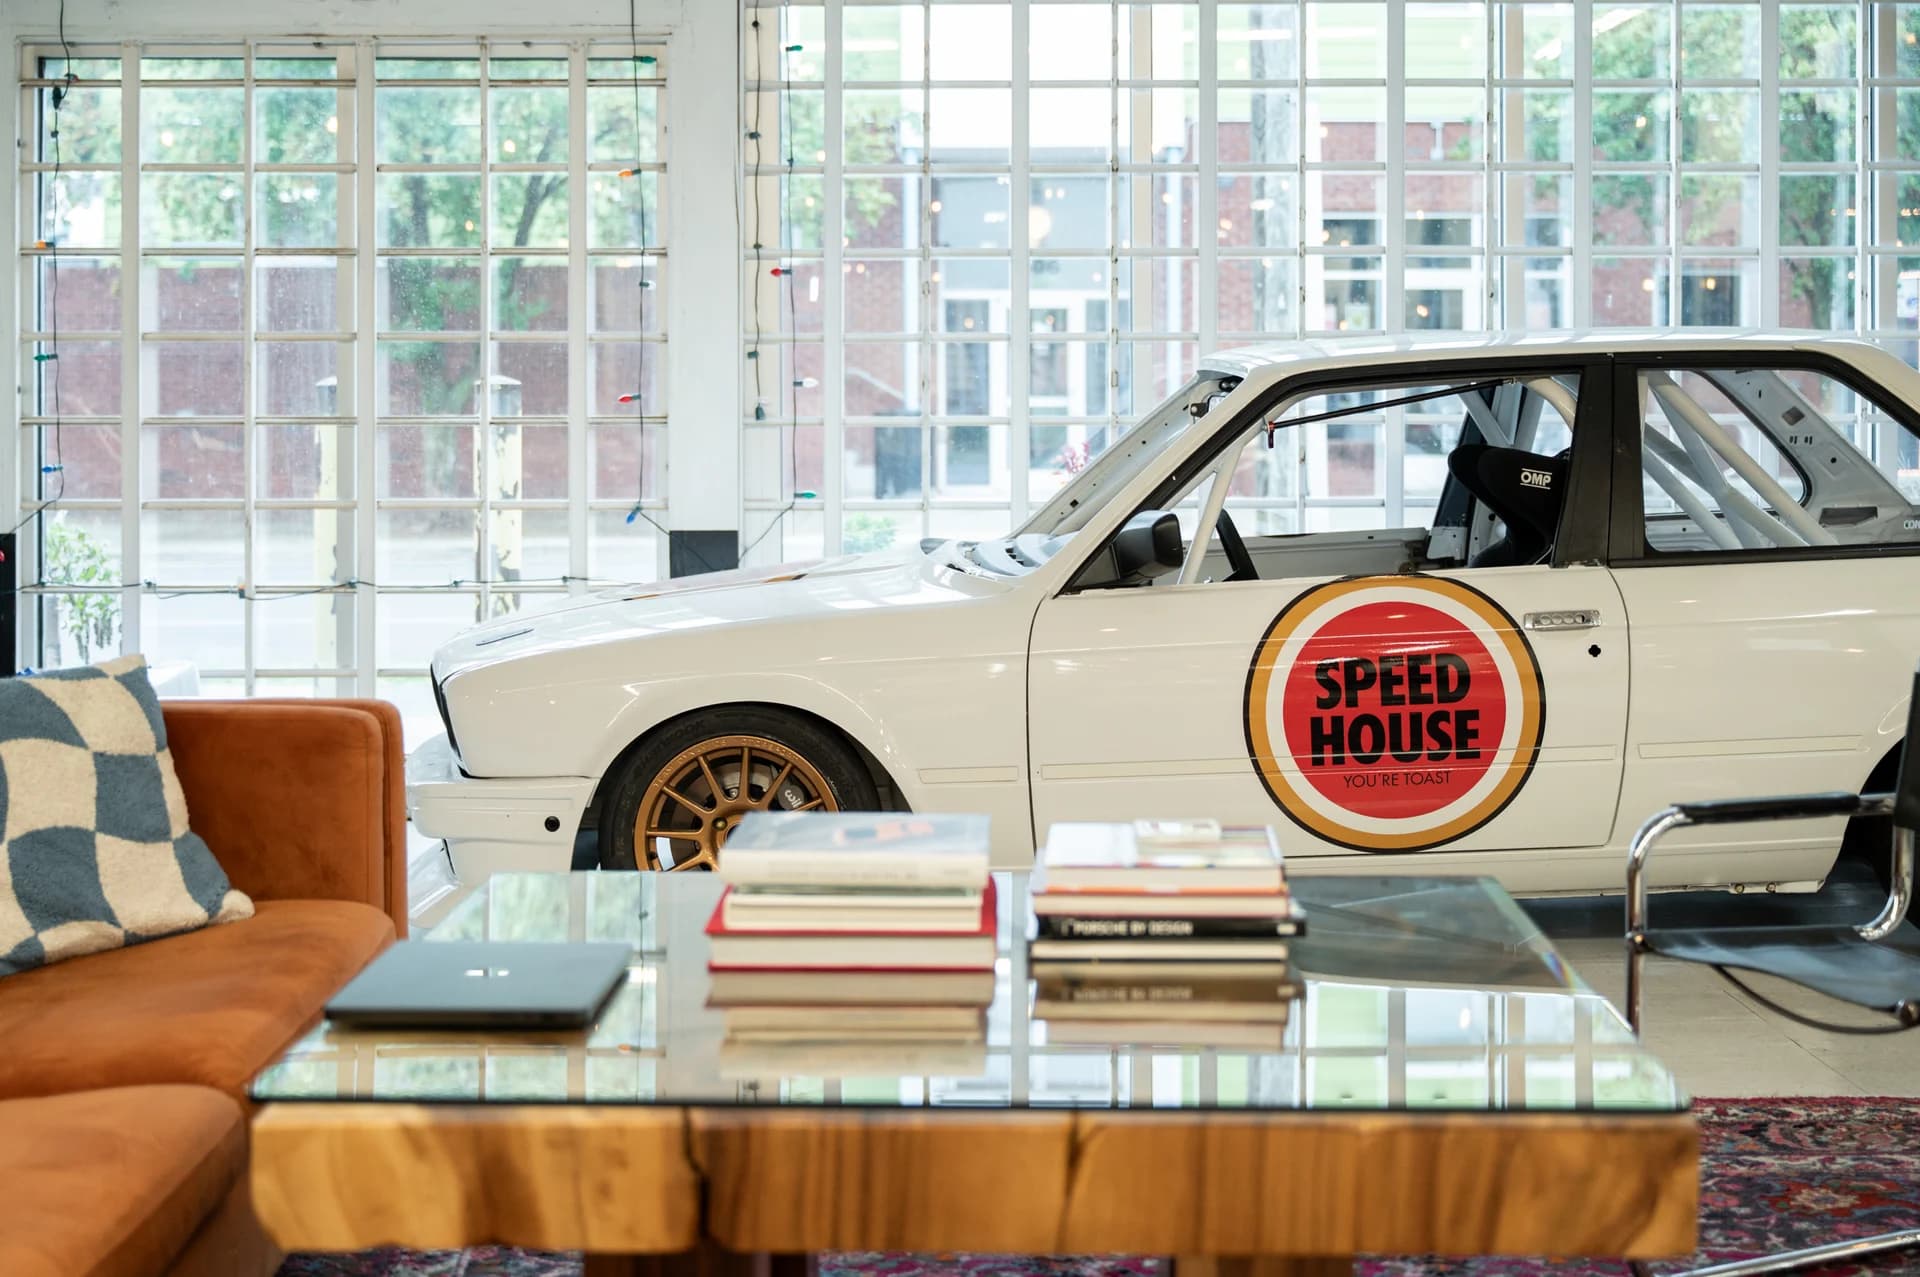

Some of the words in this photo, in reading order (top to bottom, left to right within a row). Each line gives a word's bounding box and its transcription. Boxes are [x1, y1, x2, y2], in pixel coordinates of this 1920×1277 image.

[1520, 471, 1552, 487] OMP
[1314, 653, 1471, 709] SPEED
[1310, 709, 1480, 766] HOUSE
[1343, 773, 1399, 788] YOU'RE
[1402, 770, 1453, 786] TOAST
